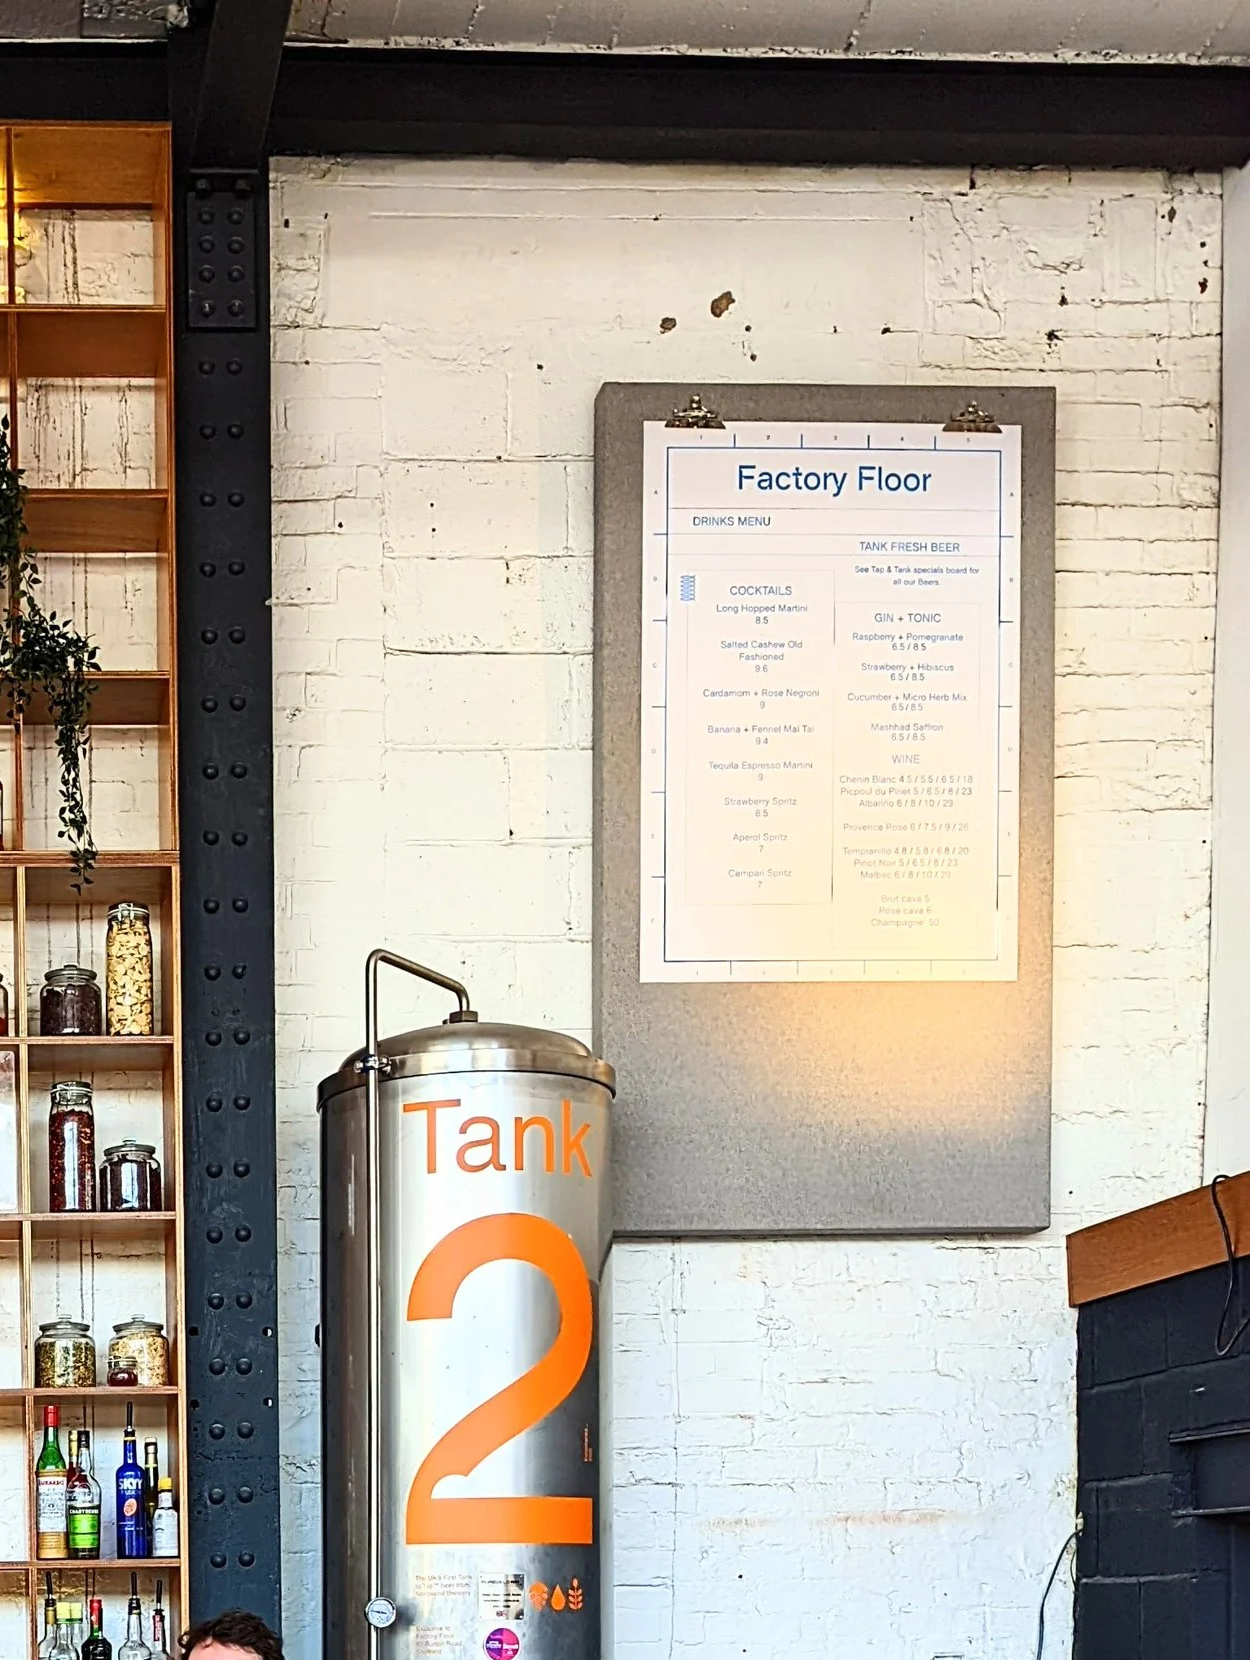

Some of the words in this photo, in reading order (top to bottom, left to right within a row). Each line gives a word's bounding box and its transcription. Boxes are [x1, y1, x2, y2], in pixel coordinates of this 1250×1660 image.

[738, 464, 848, 498] Factory
[858, 465, 932, 492] Floor
[692, 516, 735, 526] DRINKS
[737, 516, 771, 527] MENU
[859, 541, 888, 552] TANK
[891, 541, 928, 552] FRESH
[930, 542, 960, 553] BEER
[855, 565, 870, 573] See
[871, 565, 885, 574] Tap
[894, 565, 912, 574] Tank
[913, 566, 944, 574] specials
[729, 585, 792, 596] COCKTAILS
[716, 604, 739, 615] Long
[741, 604, 776, 614] Hopped
[778, 604, 808, 613] Martini
[874, 612, 894, 623] GIN
[907, 613, 941, 623] TONIC
[852, 632, 896, 643] Raspberry
[906, 632, 964, 643] Pomegranate
[720, 640, 749, 649] Salted
[750, 640, 786, 649] Cashew
[787, 640, 803, 649] Old
[739, 652, 785, 661] Fashioned
[861, 662, 907, 673] Strawberry
[917, 663, 954, 672] Hibiscus
[702, 688, 751, 698] Cardamom
[761, 688, 784, 697] Rose
[785, 688, 820, 699] Negroni
[847, 692, 892, 702] Cucumber
[902, 692, 927, 702] Micro
[928, 693, 950, 702] Herb
[707, 725, 741, 734] Banana
[751, 724, 781, 733] Fennel
[783, 724, 800, 733] Mai
[801, 724, 814, 733] Tai
[912, 722, 944, 732] Saffron
[891, 754, 920, 764] WINE
[709, 761, 739, 771] Tequila
[741, 761, 781, 770] Espresso
[783, 761, 813, 769] Martini
[724, 797, 770, 808] Strawberry
[772, 796, 798, 807] Spritz
[732, 833, 761, 842] Aperol
[763, 832, 788, 842] Spritz
[767, 868, 792, 878] Spritz
[402, 1098, 593, 1178] Tank
[406, 1212, 594, 1545] 2
[118, 1478, 142, 1490] SKYY
